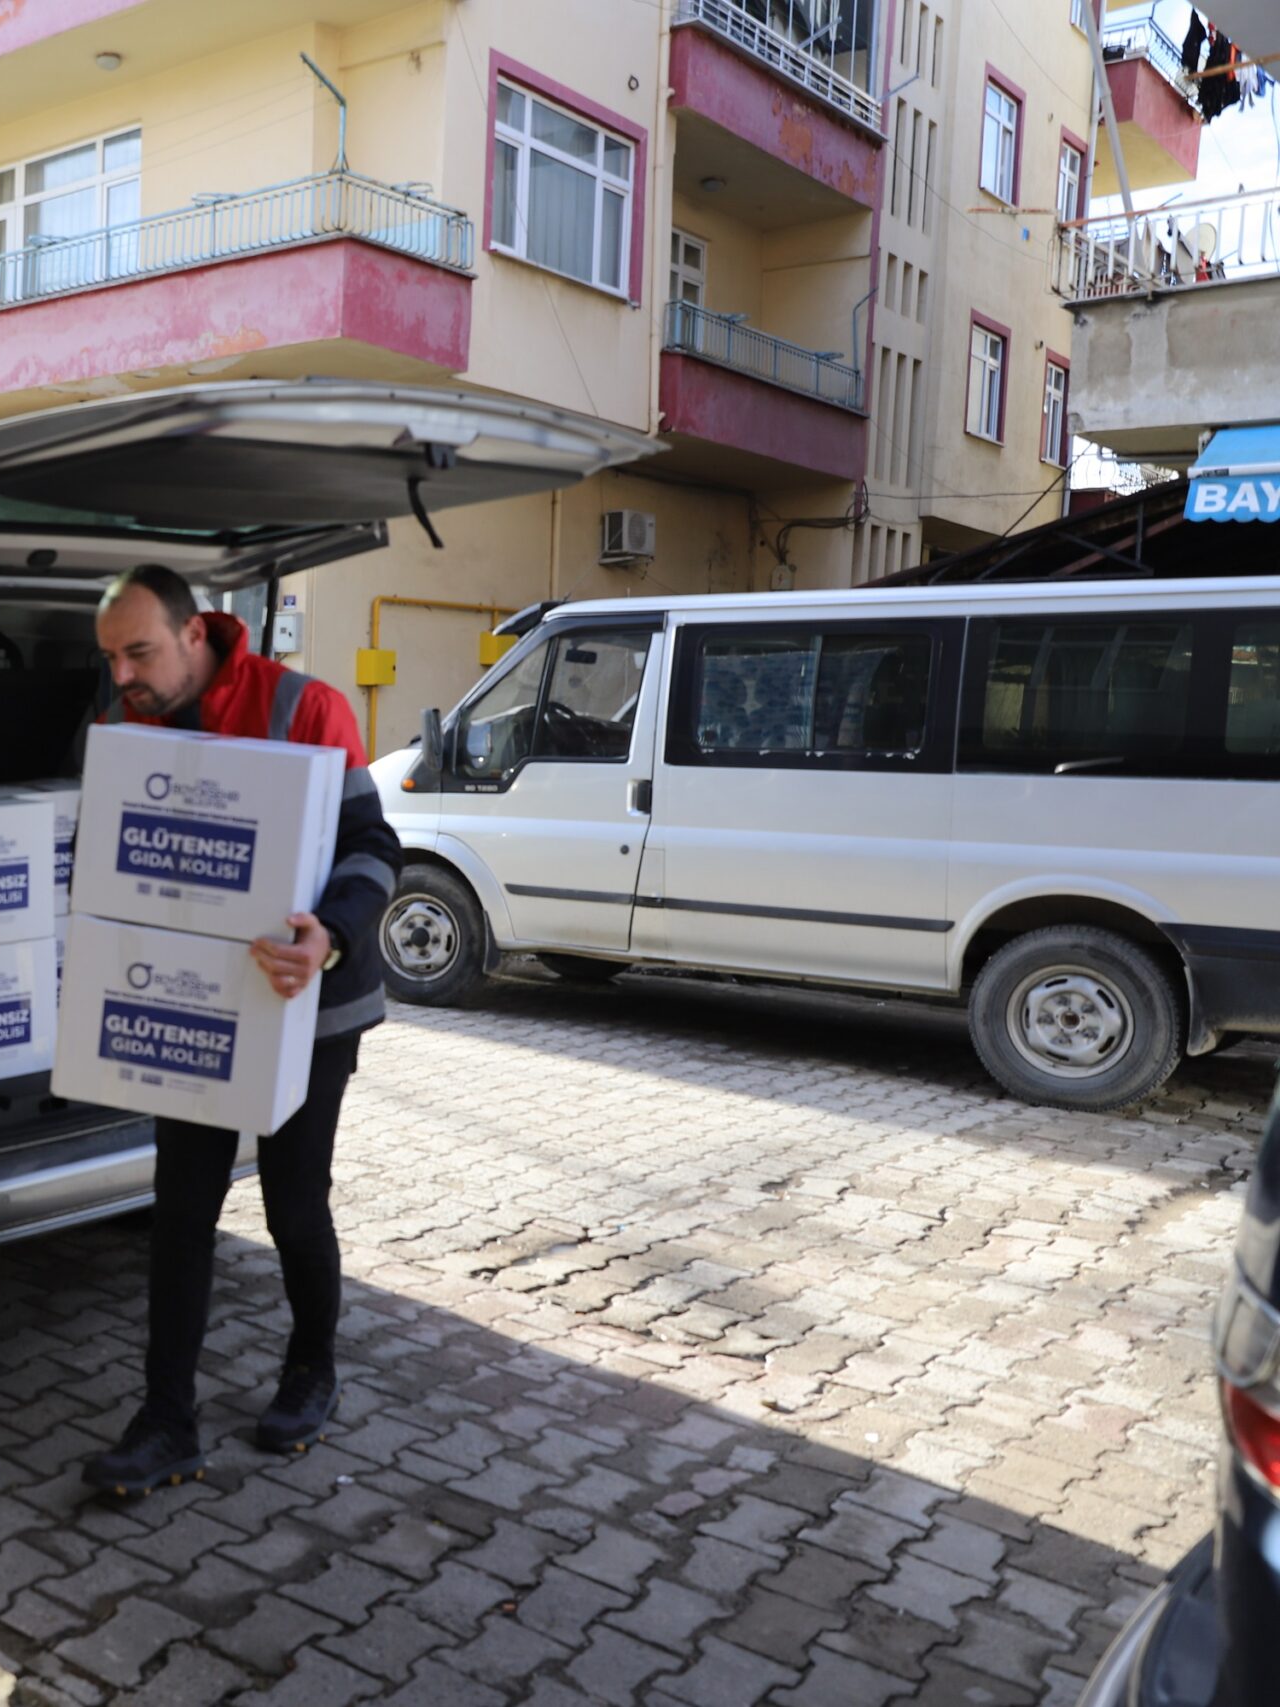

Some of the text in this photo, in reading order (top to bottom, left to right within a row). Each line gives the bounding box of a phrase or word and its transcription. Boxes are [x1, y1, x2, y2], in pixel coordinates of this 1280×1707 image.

[122, 826, 251, 863] GLÜTENSİZ
[128, 849, 175, 870] GIDA
[104, 1014, 232, 1053] GLÜTENSİZ
[111, 1036, 156, 1058] GIDA
